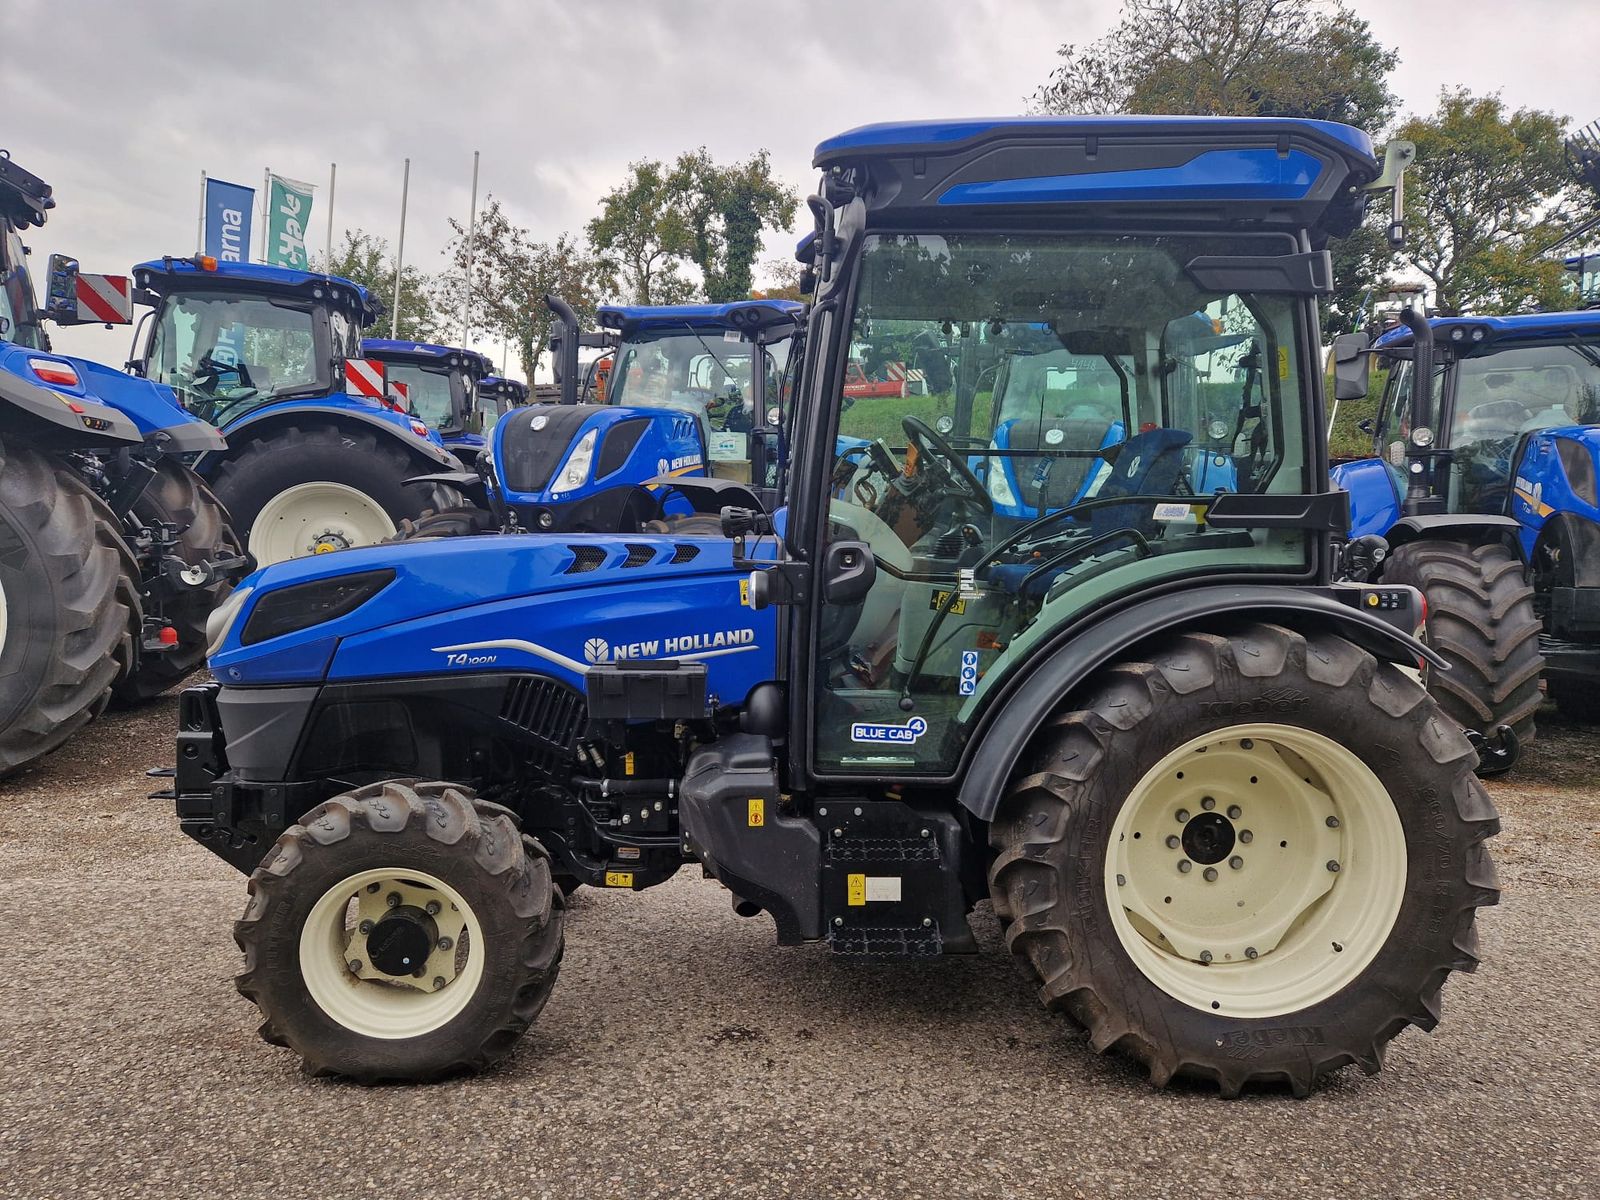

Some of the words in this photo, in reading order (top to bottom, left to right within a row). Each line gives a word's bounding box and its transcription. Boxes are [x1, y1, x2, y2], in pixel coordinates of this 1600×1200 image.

[613, 640, 658, 660] NEW
[664, 628, 754, 653] HOLLAND
[855, 727, 887, 739] BLUE
[888, 729, 913, 740] CAB
[911, 720, 924, 732] 4
